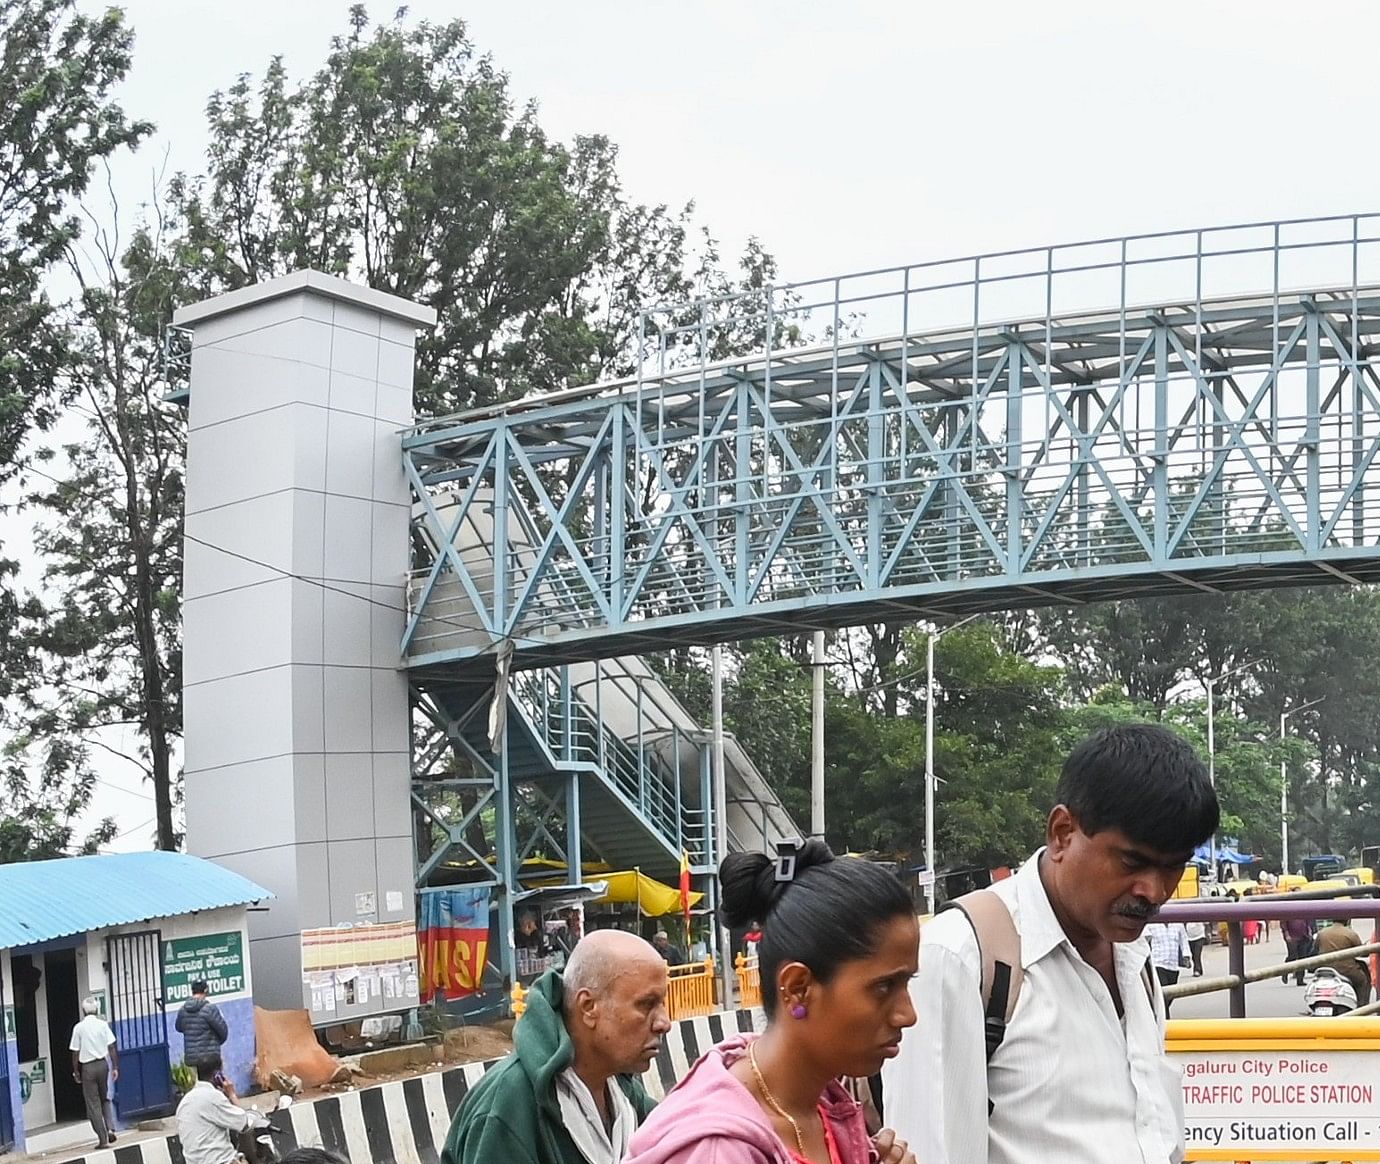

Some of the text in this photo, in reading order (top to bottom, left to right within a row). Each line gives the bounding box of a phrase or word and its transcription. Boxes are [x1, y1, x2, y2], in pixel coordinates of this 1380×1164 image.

[207, 969, 221, 978] USE
[207, 976, 242, 993] TOILET
[1183, 1059, 1328, 1077] galuru City Police
[1183, 1086, 1372, 1104] TRAFFIC POLICE STATION
[1230, 1122, 1316, 1140] Situation
[1323, 1121, 1357, 1140] Call
